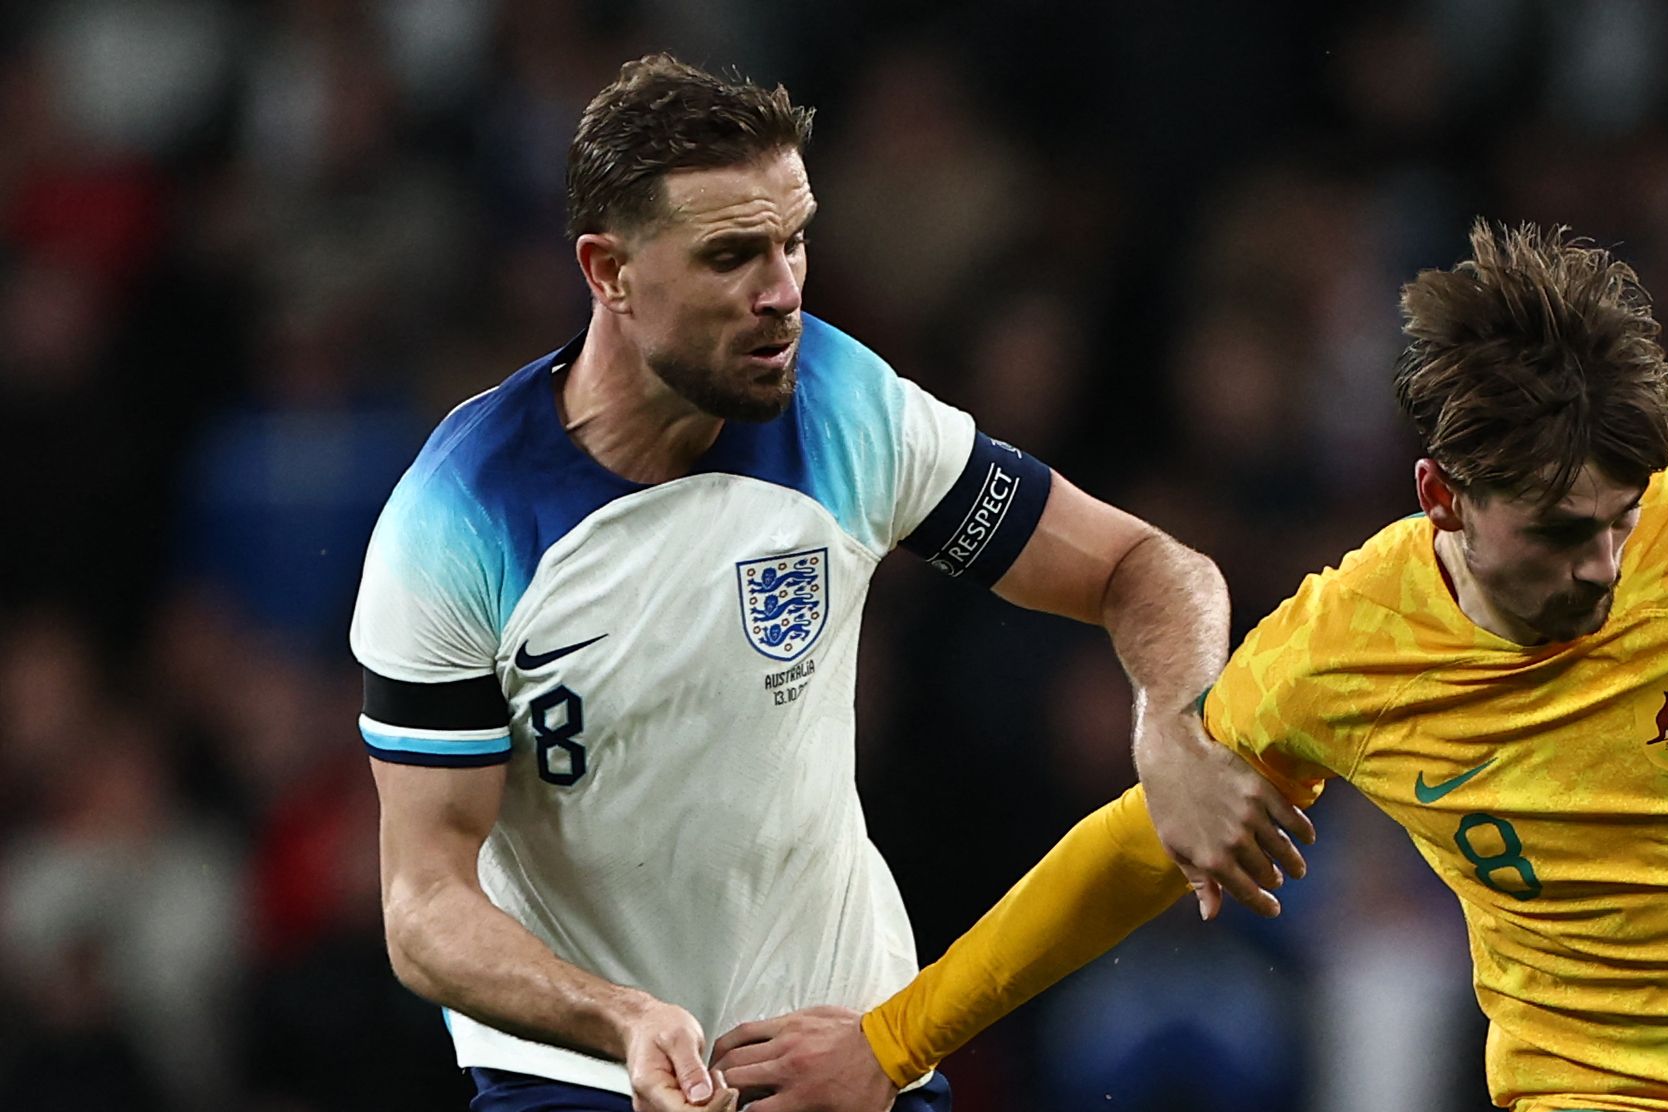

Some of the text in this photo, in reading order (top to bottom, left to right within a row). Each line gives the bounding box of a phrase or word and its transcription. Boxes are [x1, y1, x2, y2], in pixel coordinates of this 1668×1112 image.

[949, 467, 1012, 562] RESPECT
[765, 659, 816, 690] AUSTRALIA
[529, 684, 587, 787] 8
[1454, 812, 1543, 900] 8
